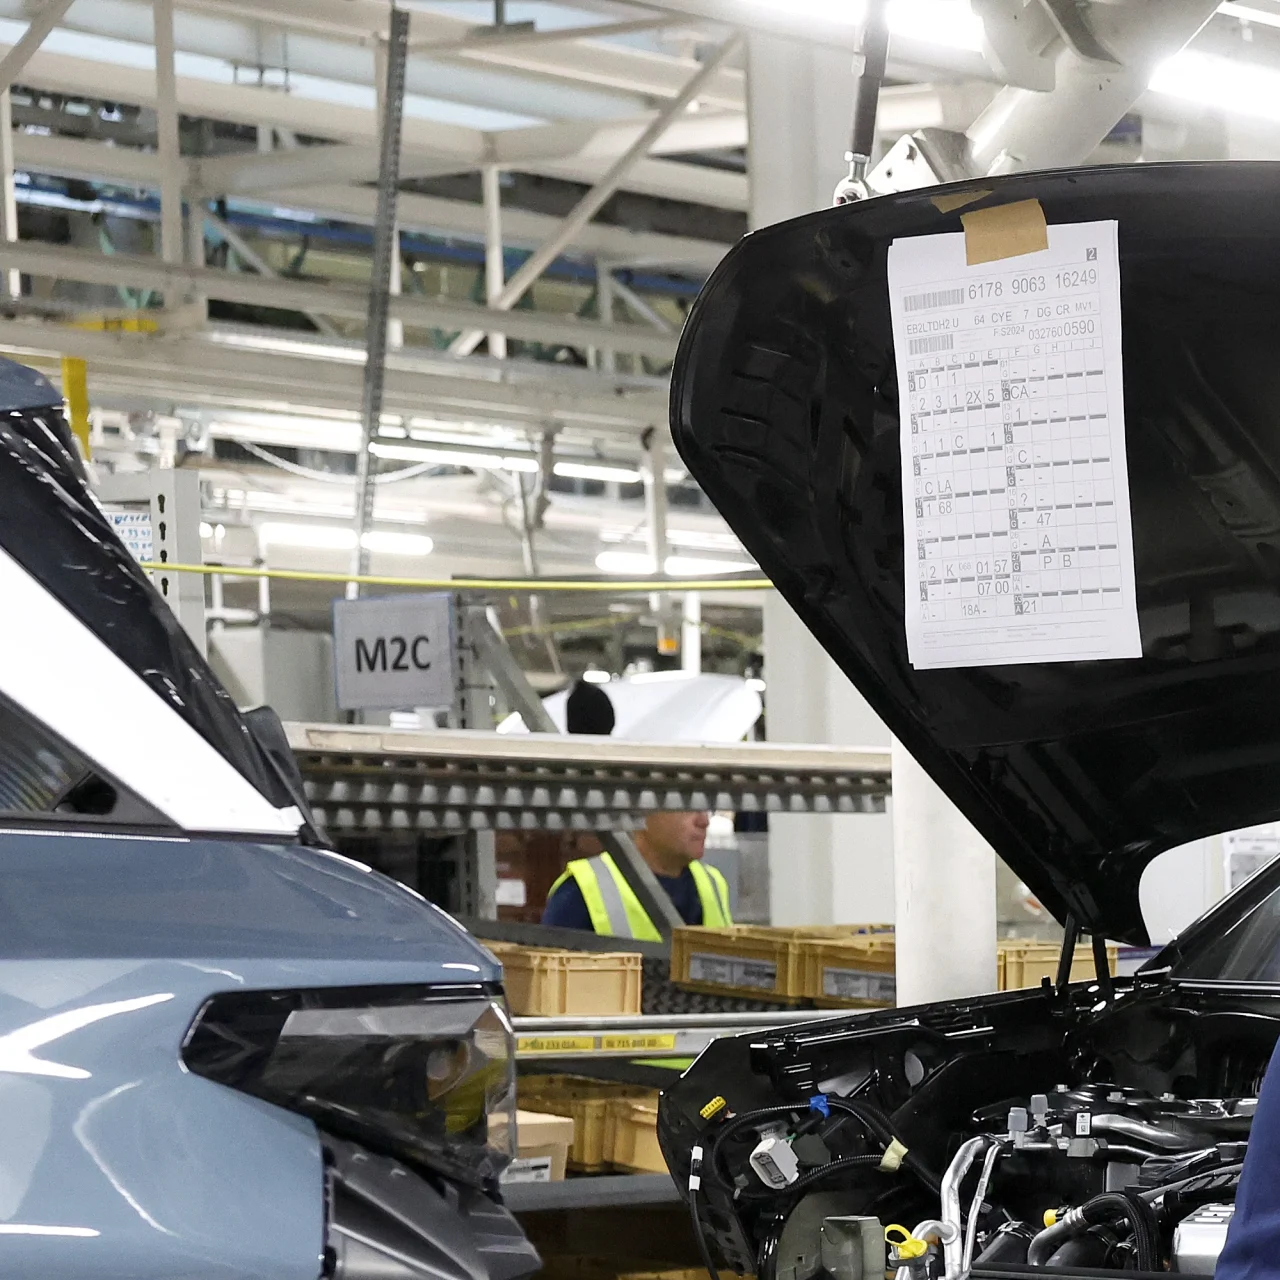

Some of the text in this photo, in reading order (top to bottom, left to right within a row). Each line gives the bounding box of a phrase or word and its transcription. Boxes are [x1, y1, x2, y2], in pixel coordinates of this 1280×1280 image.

[968, 269, 1097, 300] 6178 9063 16249
[974, 315, 985, 326] 64
[991, 311, 1012, 324] CYE
[1024, 310, 1029, 319] 7
[1037, 307, 1051, 318] DG
[1056, 305, 1070, 316] CR
[919, 376, 926, 389] D
[935, 375, 940, 386] 1
[952, 372, 957, 385] 1
[1011, 385, 1029, 399] CA
[919, 398, 926, 410] 2
[936, 395, 942, 408] 3
[953, 393, 958, 406] 1
[966, 390, 982, 404] 2X
[988, 389, 995, 401] 5
[1016, 408, 1021, 420] 1
[923, 440, 928, 452] 1
[939, 438, 944, 450] 1
[955, 435, 963, 448] C
[991, 432, 996, 444] 1
[1018, 450, 1027, 463] C
[925, 482, 933, 494] C
[938, 480, 952, 493] LA
[939, 501, 952, 514] 68
[1037, 513, 1051, 526] 47
[1042, 535, 1051, 548] A
[1044, 556, 1052, 569] P
[1063, 554, 1072, 568] B
[929, 566, 936, 578] 2
[946, 564, 954, 576] K
[976, 561, 989, 574] 01
[994, 560, 1008, 573] 57
[978, 582, 991, 595] 07
[995, 581, 1009, 594] 00
[962, 604, 980, 616] 18A
[1023, 600, 1037, 613] 21
[355, 635, 431, 672] M2C
